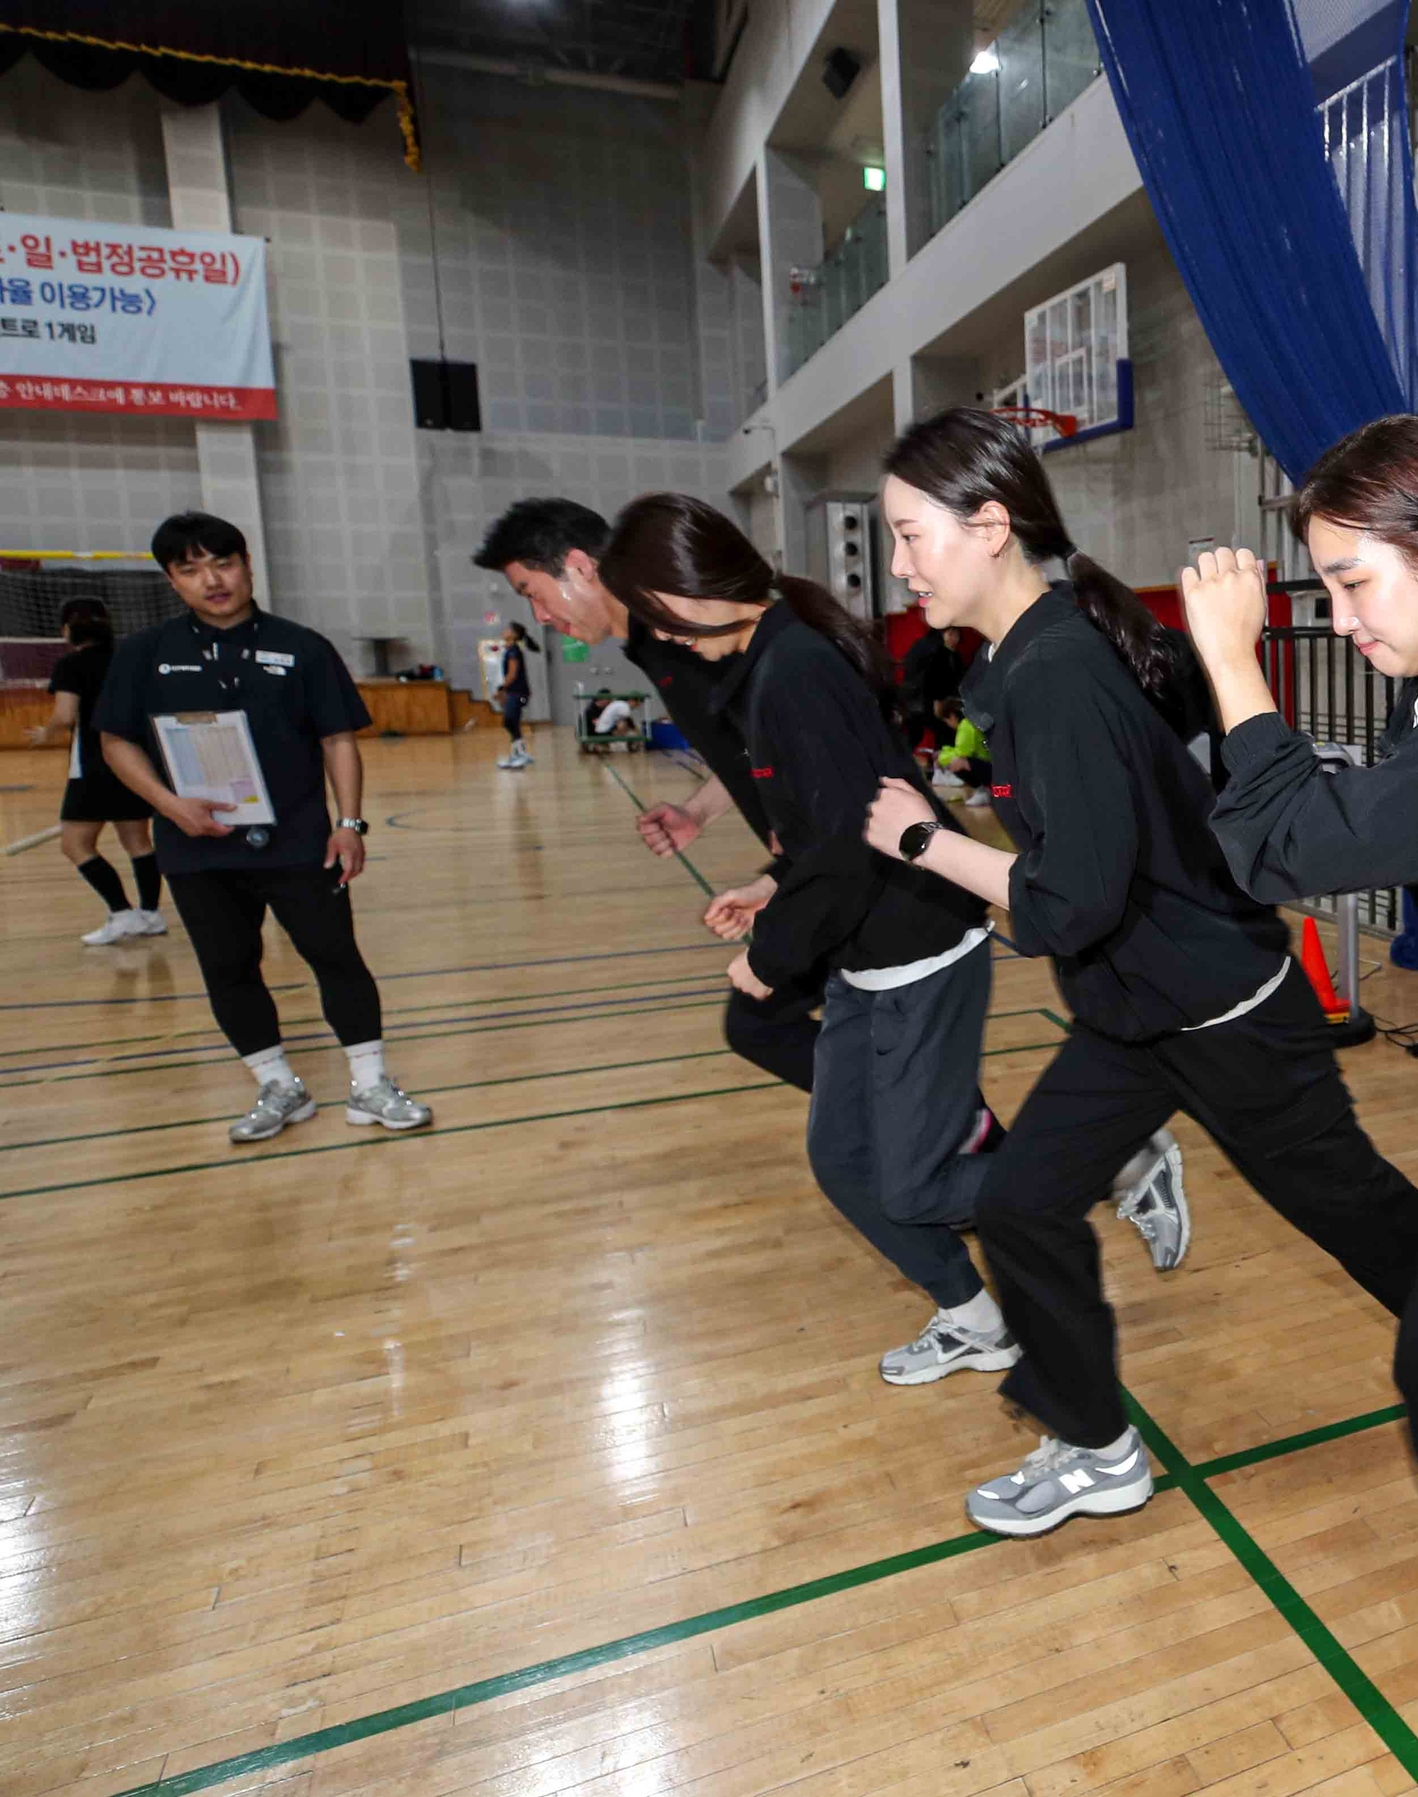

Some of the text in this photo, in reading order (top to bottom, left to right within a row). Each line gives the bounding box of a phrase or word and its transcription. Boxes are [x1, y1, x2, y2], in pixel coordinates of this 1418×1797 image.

[0, 234, 240, 287] ·일·법정공휴일)
[46, 320, 96, 345] 1게임
[1059, 1468, 1095, 1494] N
